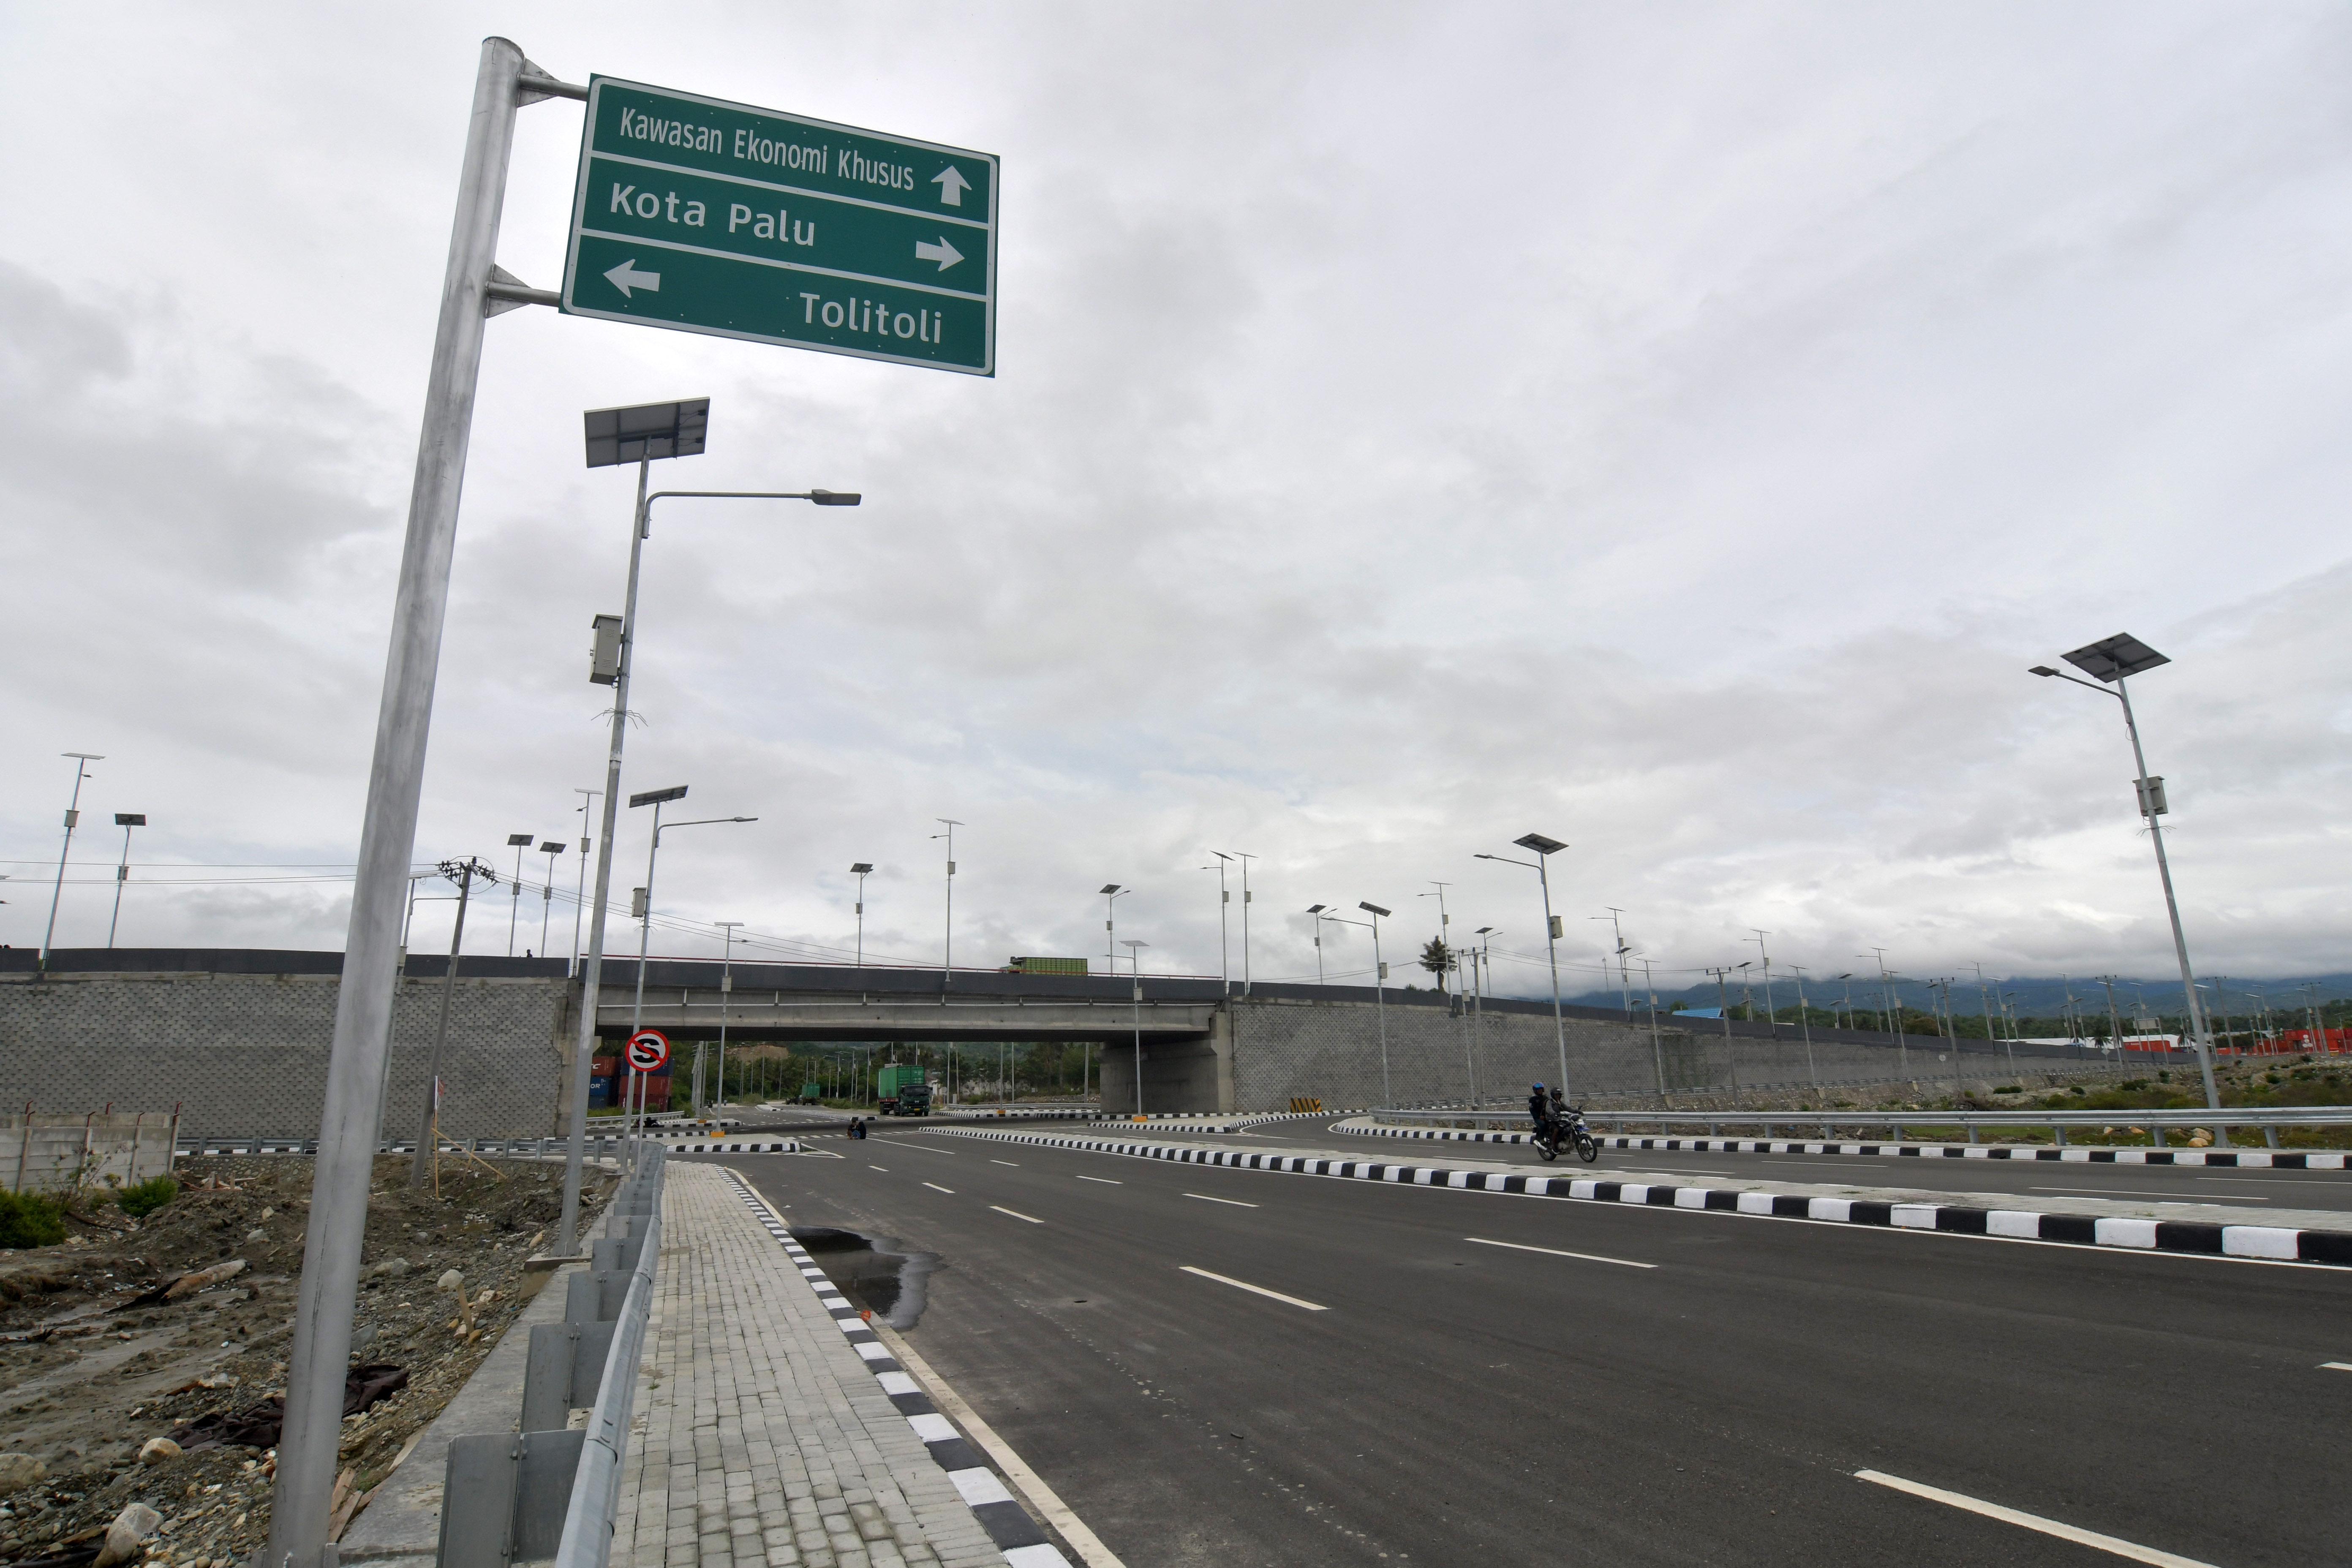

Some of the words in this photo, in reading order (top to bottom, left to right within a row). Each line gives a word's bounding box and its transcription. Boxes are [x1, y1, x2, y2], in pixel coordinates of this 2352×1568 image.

[621, 107, 722, 154] Kawasan
[734, 129, 827, 174] Ekonomi
[838, 150, 914, 191] Khusus
[611, 183, 705, 227] Kota
[729, 204, 814, 246] Palu
[800, 292, 942, 343] Tolitoli
